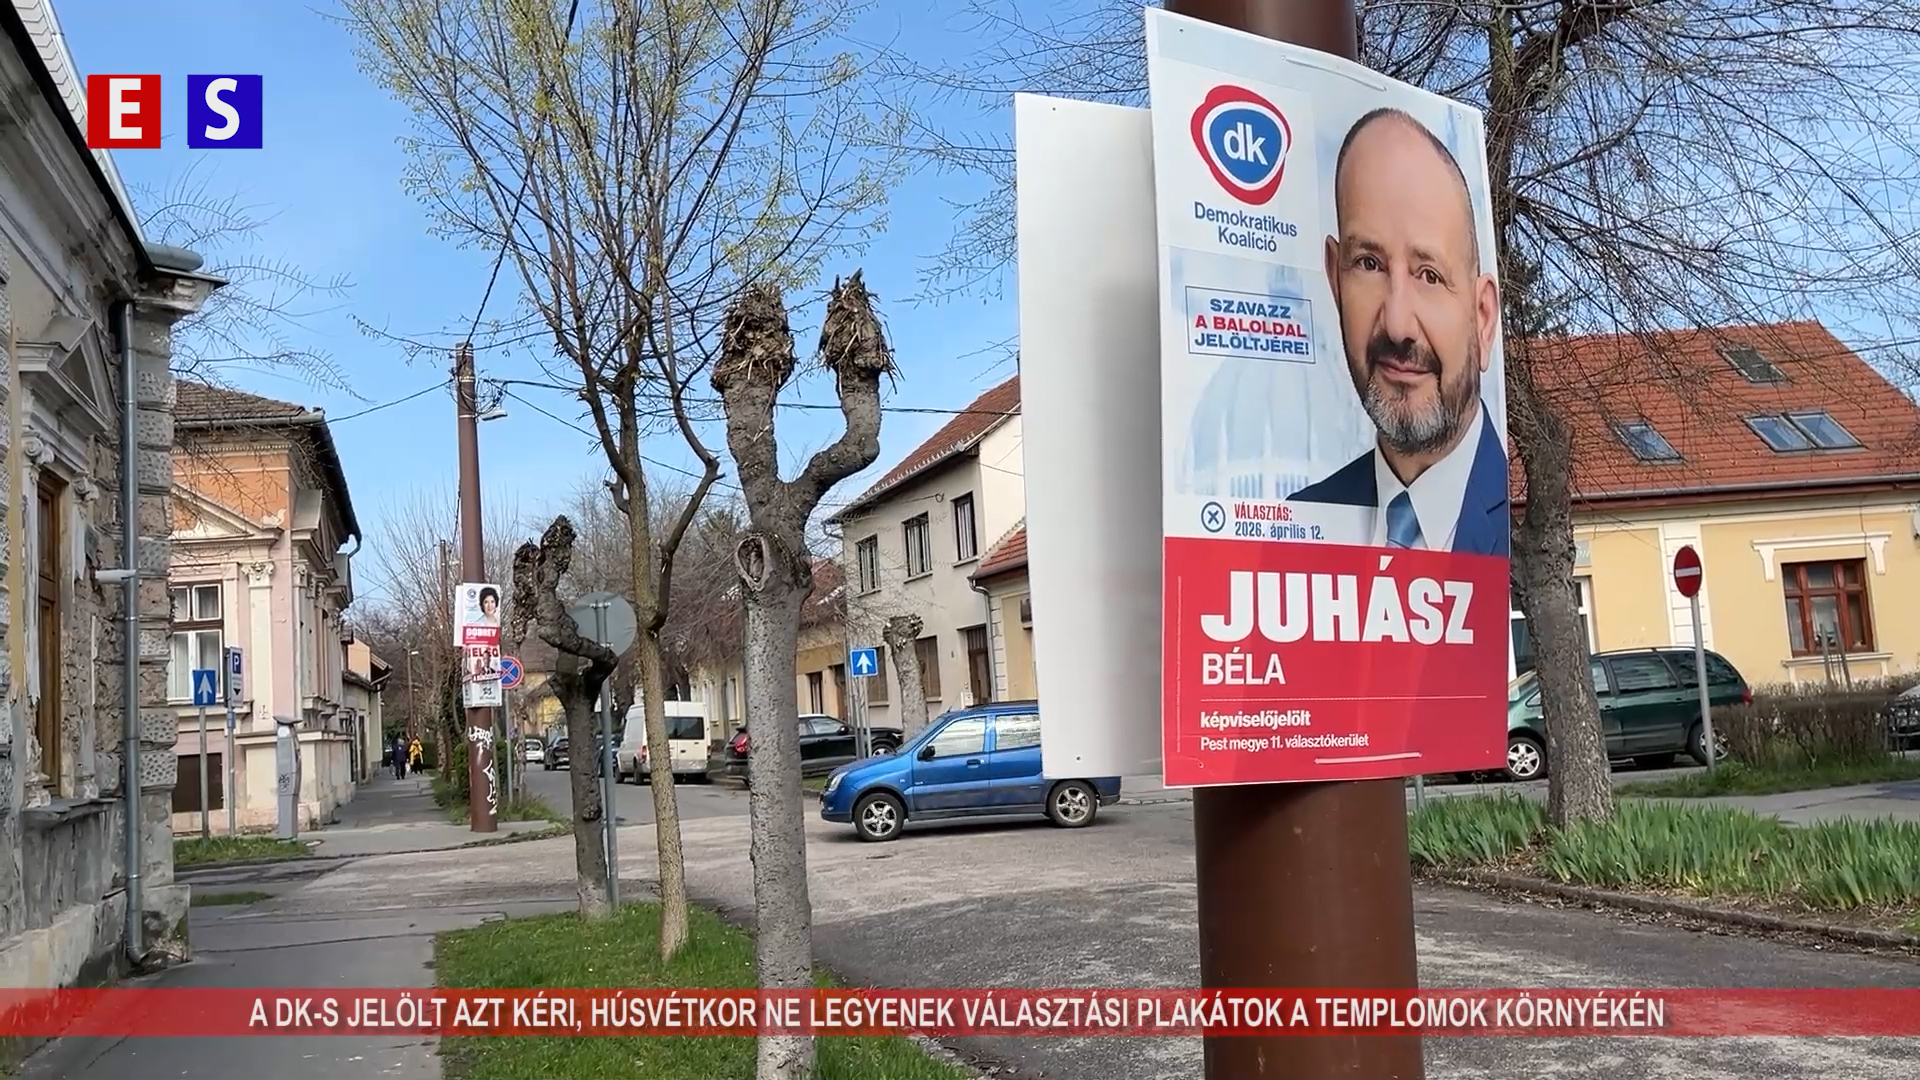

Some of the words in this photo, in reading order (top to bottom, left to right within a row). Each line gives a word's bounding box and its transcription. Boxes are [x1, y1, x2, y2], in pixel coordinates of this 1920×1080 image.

[1223, 122, 1269, 166] dk
[1193, 201, 1298, 238] Demokratikus
[1217, 226, 1278, 253] Koalíció
[1209, 297, 1292, 320] SZAVAZZ
[1195, 316, 1210, 330] A
[1213, 317, 1307, 338] BALOLDAL
[1194, 332, 1310, 356] JELÖLTJÉRE!
[1234, 503, 1293, 522] VÁLASZTÁS:
[1234, 521, 1266, 538] 2026.
[1270, 522, 1307, 541] április
[1310, 525, 1325, 540] 12.
[1200, 555, 1474, 645] JUHÁSZ
[234, 655, 240, 671] P
[1201, 646, 1286, 685] BÉLA
[1200, 710, 1312, 730] képviselőjelölt
[1200, 736, 1228, 751] Pest
[1228, 738, 1269, 752] megye
[1270, 735, 1284, 748] 11.
[1285, 733, 1369, 749] választókerület
